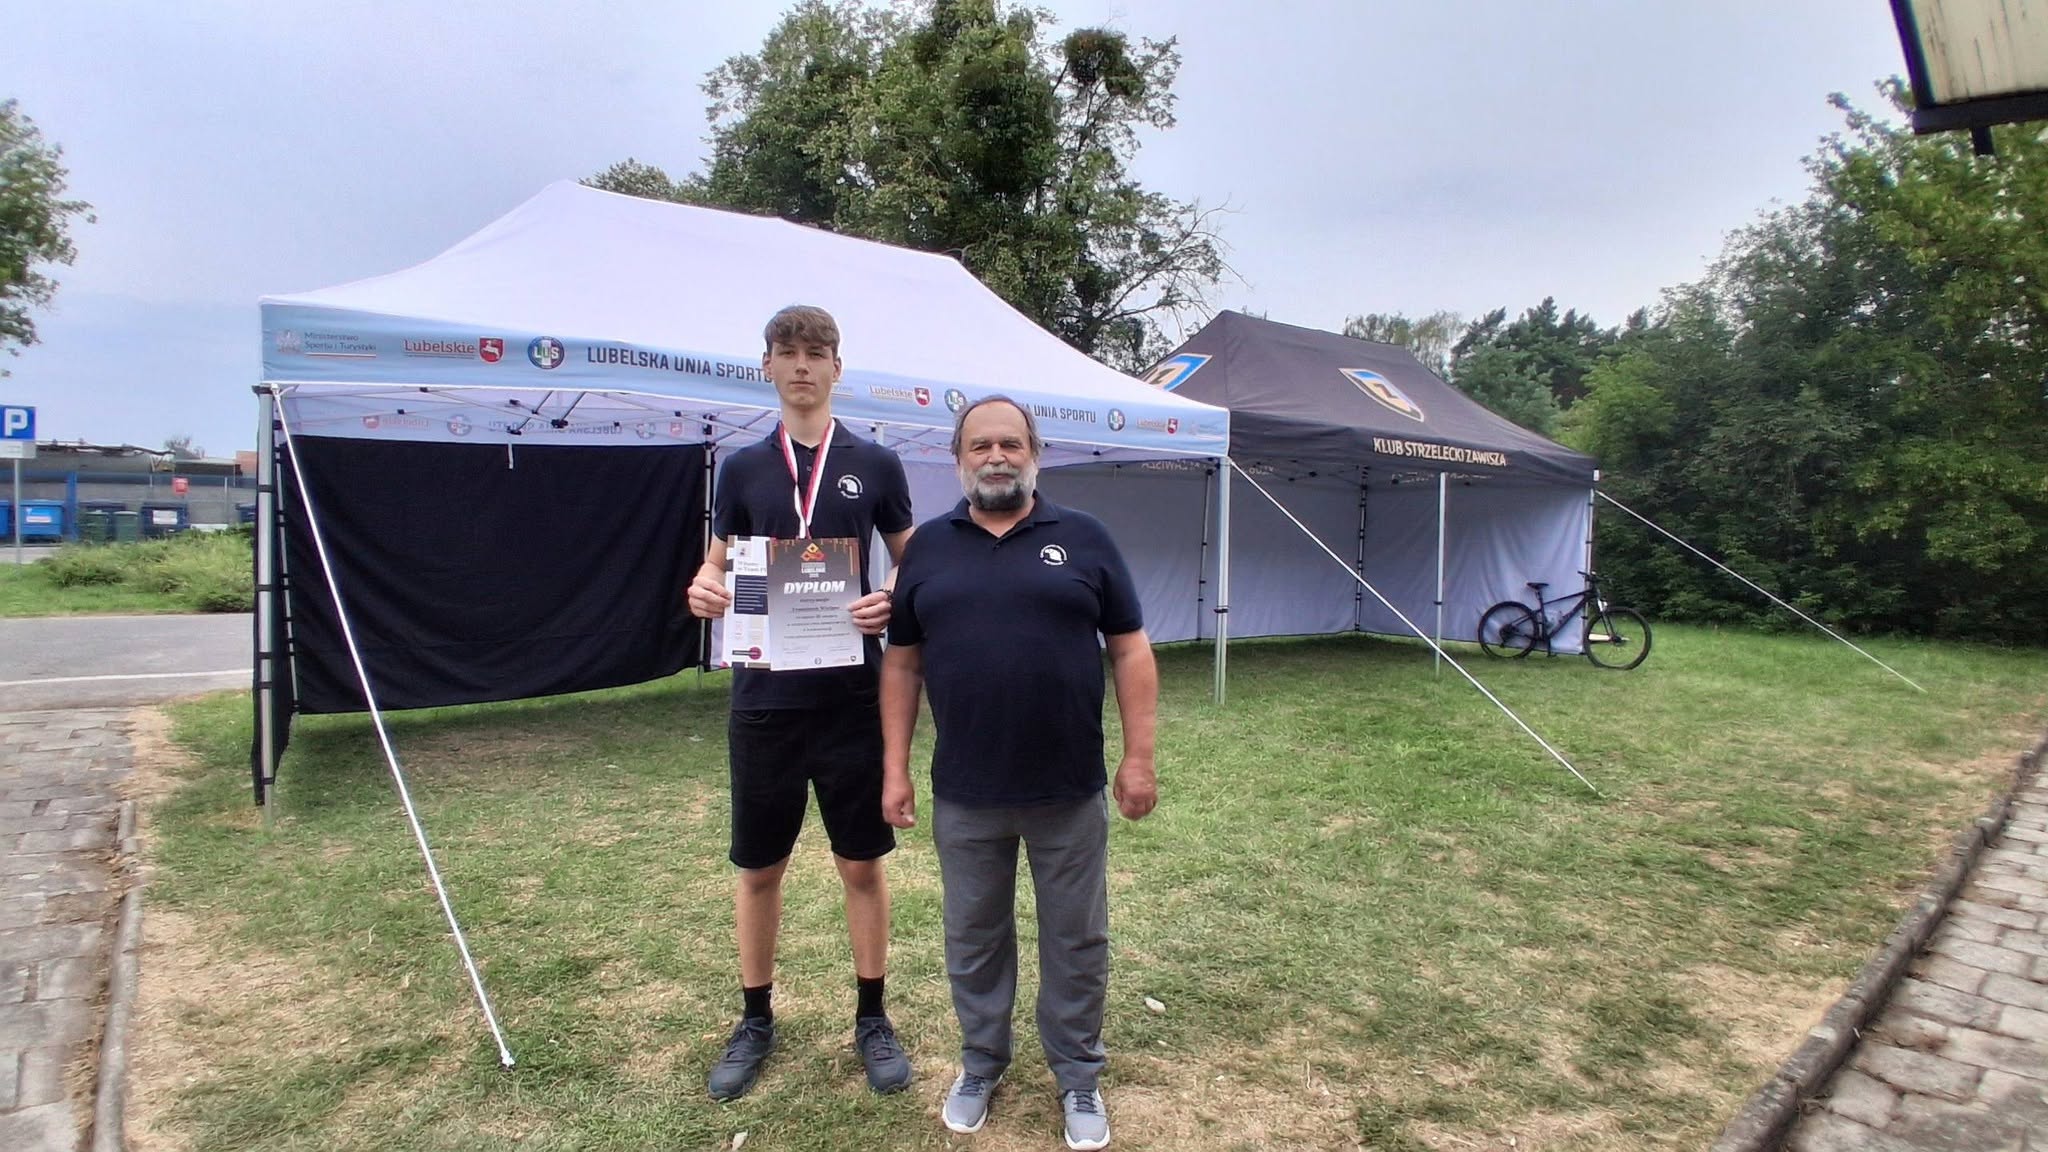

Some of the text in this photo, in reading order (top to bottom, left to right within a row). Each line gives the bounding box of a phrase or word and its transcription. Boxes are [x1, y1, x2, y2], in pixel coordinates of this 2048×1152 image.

[404, 339, 475, 353] Lubelskie
[587, 346, 670, 370] LUBELSKA
[674, 356, 712, 376] UNIA
[869, 384, 913, 398] Lubelskie
[5, 408, 28, 437] P
[1034, 405, 1058, 419] UNIA
[1060, 407, 1097, 423] SPORTU
[1373, 437, 1507, 467] KLUB STRZELECKI ZAWISZA
[783, 580, 846, 595] DYPLOM
